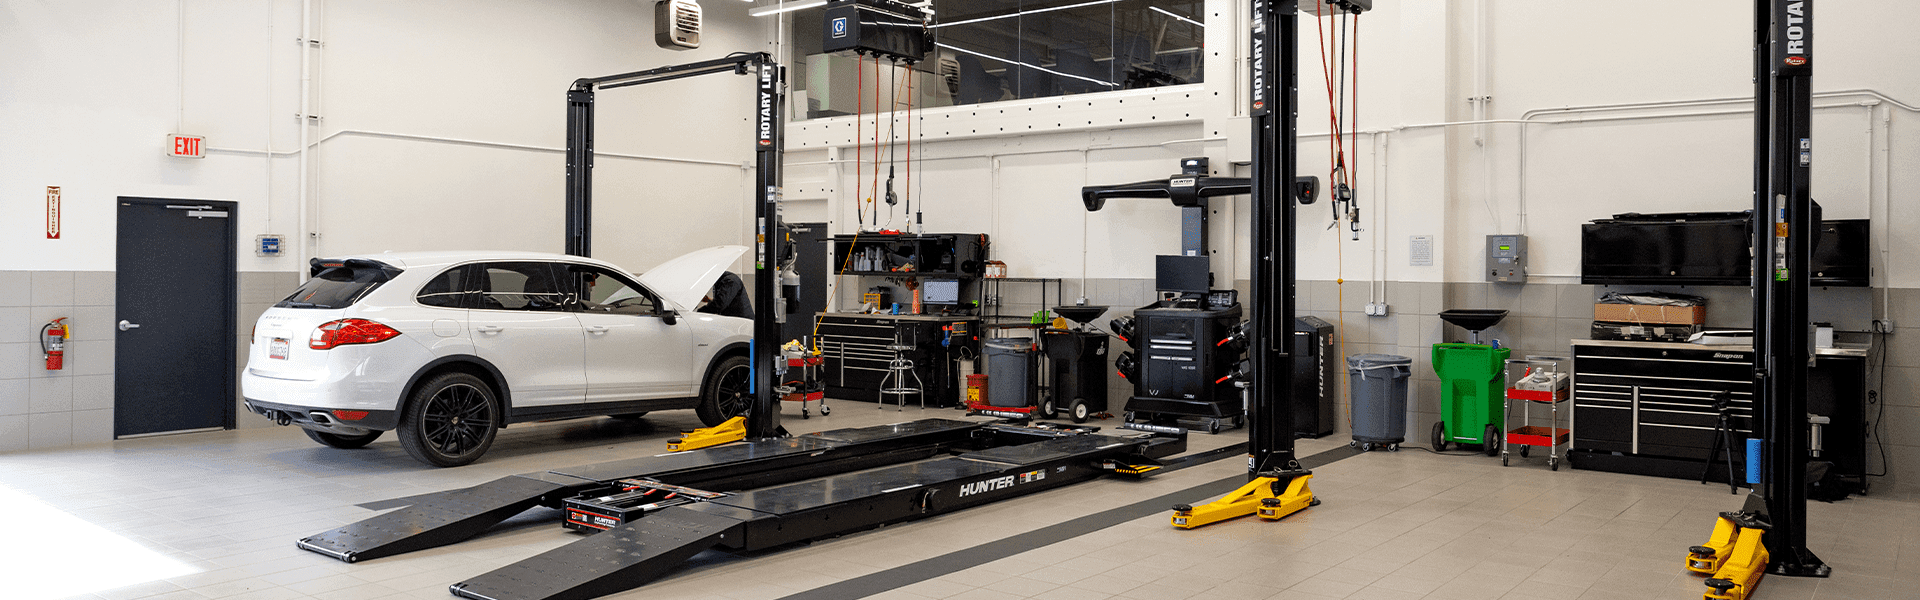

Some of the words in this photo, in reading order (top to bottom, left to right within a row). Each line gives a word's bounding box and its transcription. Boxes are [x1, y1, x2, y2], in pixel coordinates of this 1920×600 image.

[1254, 0, 1262, 34] LIFT
[1787, 0, 1803, 54] ROTA
[762, 64, 772, 89] LIFT
[1254, 38, 1262, 101] ROTARY
[761, 92, 771, 139] ROTARY
[175, 137, 201, 156] EXIT
[959, 475, 1014, 497] HUNTER
[594, 516, 616, 526] HUNTER
